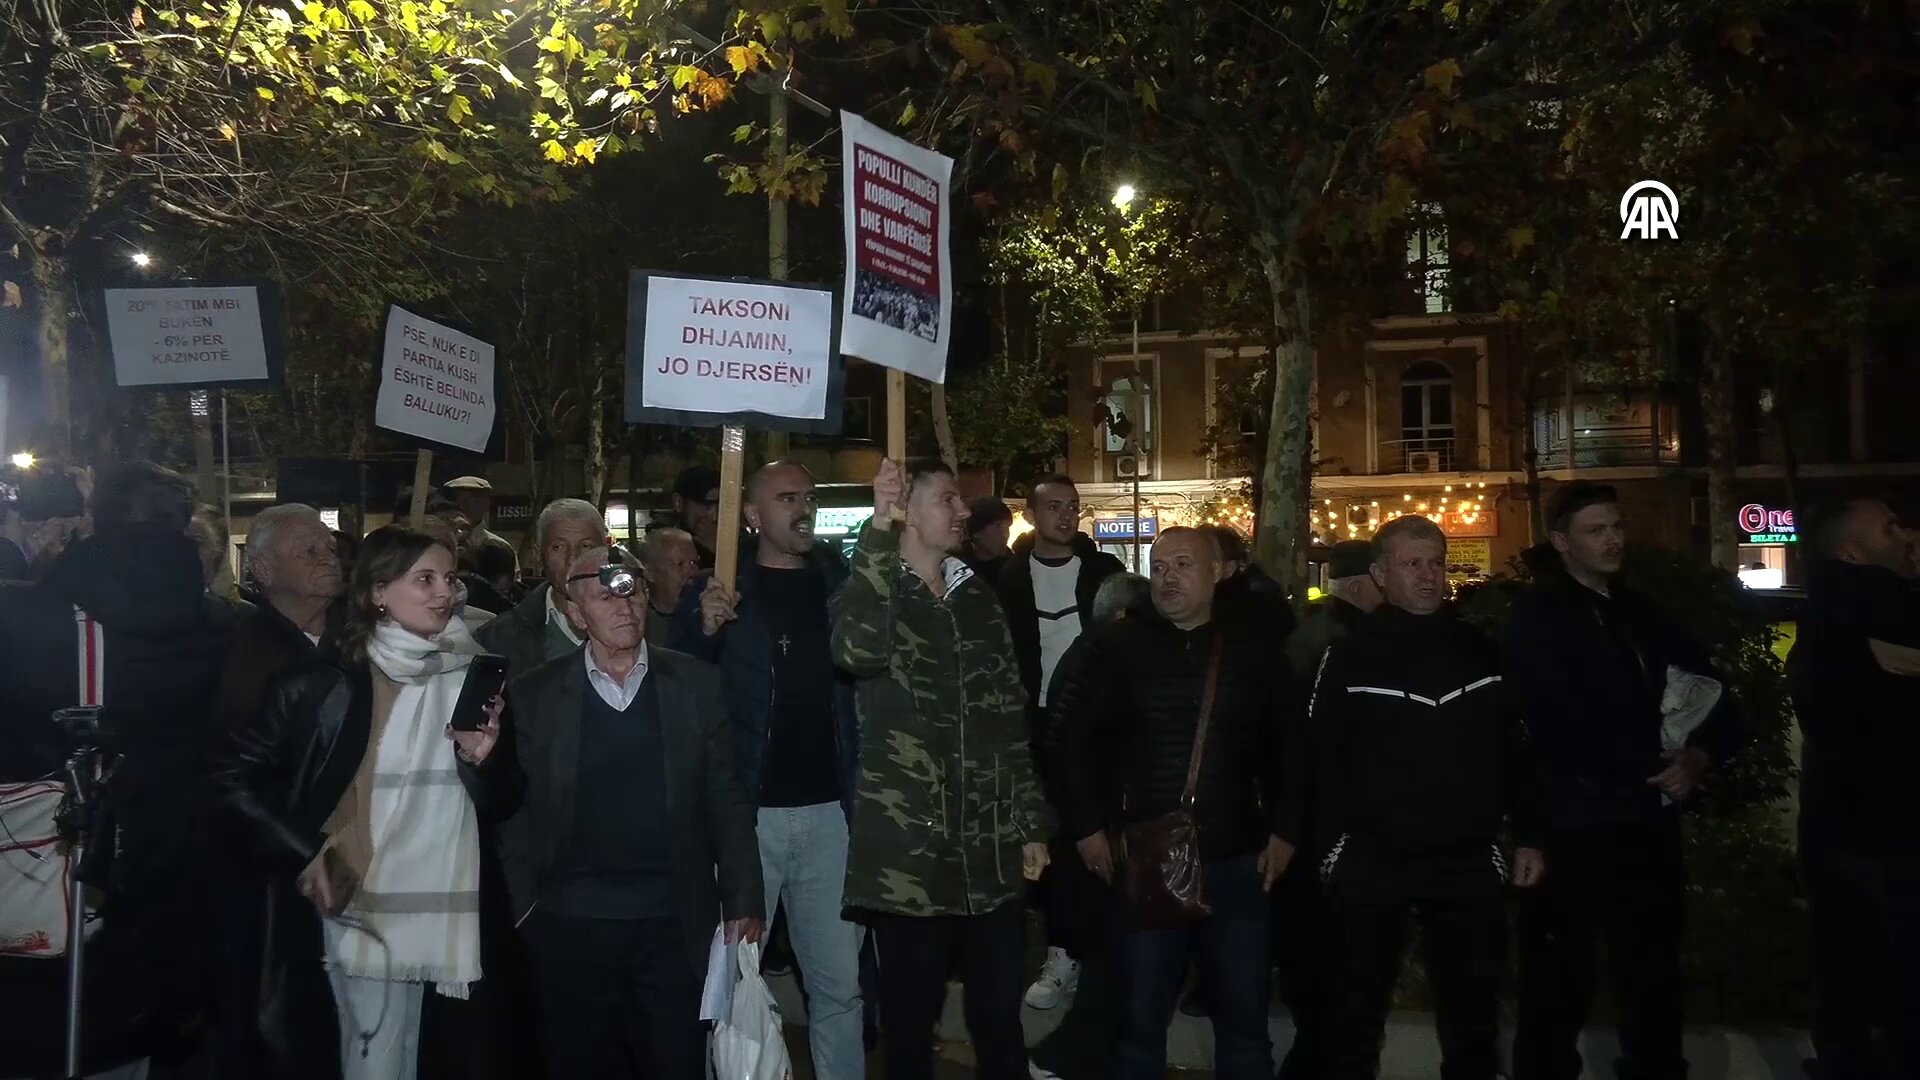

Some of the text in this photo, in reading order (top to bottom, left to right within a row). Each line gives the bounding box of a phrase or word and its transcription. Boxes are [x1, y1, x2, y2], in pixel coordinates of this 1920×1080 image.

[858, 149, 901, 185] POPULLI
[860, 207, 881, 234] DHE
[212, 299, 240, 310] MBI
[688, 296, 790, 321] TAKSONI
[164, 336, 188, 347] 6%
[192, 334, 224, 346] PER
[403, 325, 480, 364] PSE, NUK E DI
[682, 326, 793, 355] DHJAMIN,
[152, 348, 231, 364] KAZINOTË
[403, 348, 477, 384] PARTIA KUSH
[658, 356, 811, 385] JO DJERSËN!
[394, 365, 485, 407] ËSHTË BELINDA
[404, 394, 471, 424] BALLUKU?!
[1739, 504, 1794, 533] One
